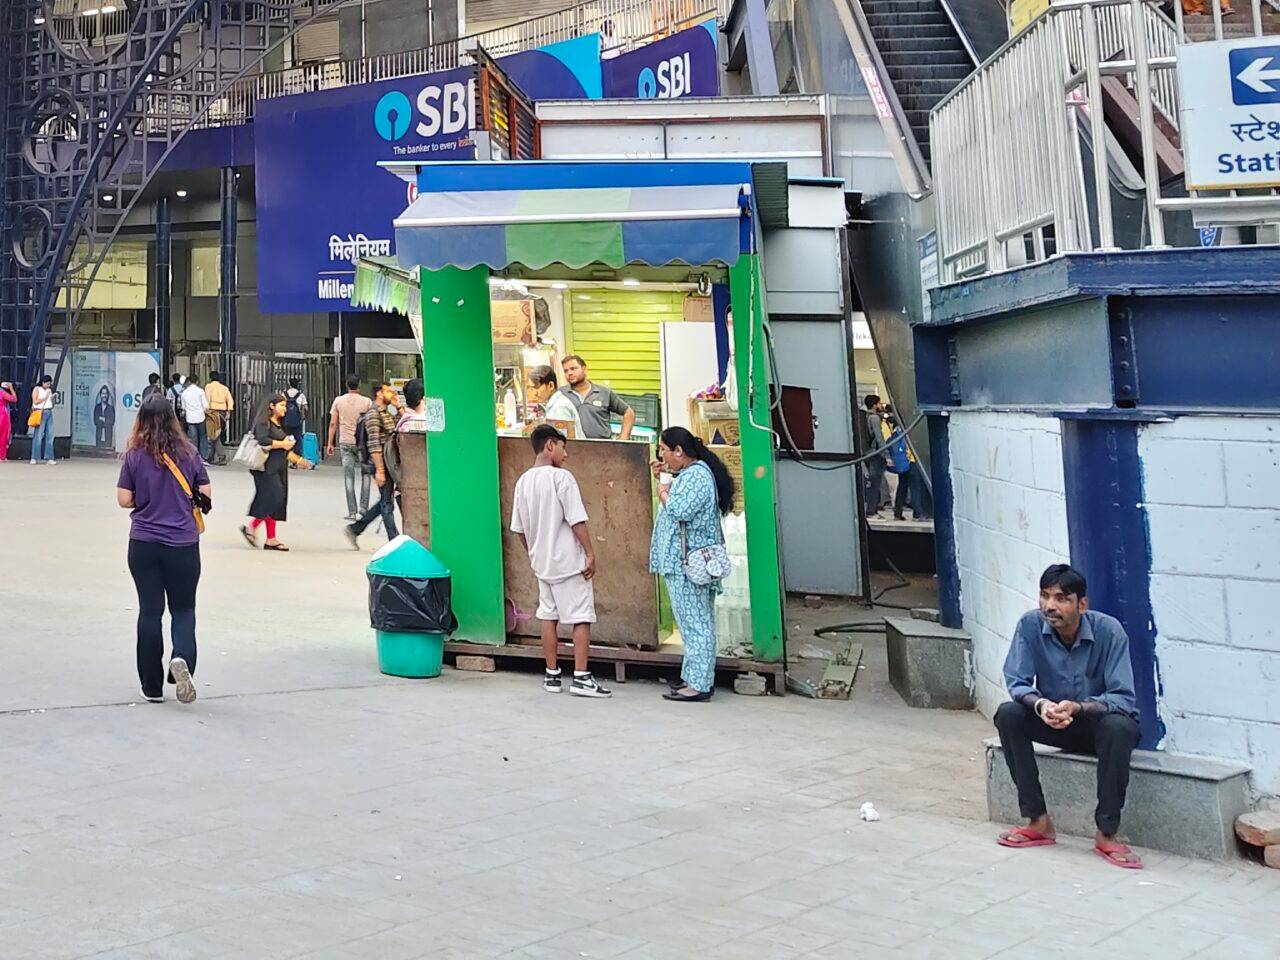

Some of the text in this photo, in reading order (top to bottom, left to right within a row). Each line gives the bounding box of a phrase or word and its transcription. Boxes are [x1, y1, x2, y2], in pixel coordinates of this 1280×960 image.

[657, 52, 691, 98] SBI
[416, 78, 476, 137] SBI
[393, 145, 407, 155] The
[407, 143, 430, 154] banker
[431, 143, 438, 151] to
[440, 141, 457, 150] every
[329, 234, 390, 260] मिलेनियम
[318, 279, 355, 299] Millen
[55, 391, 65, 405] BI
